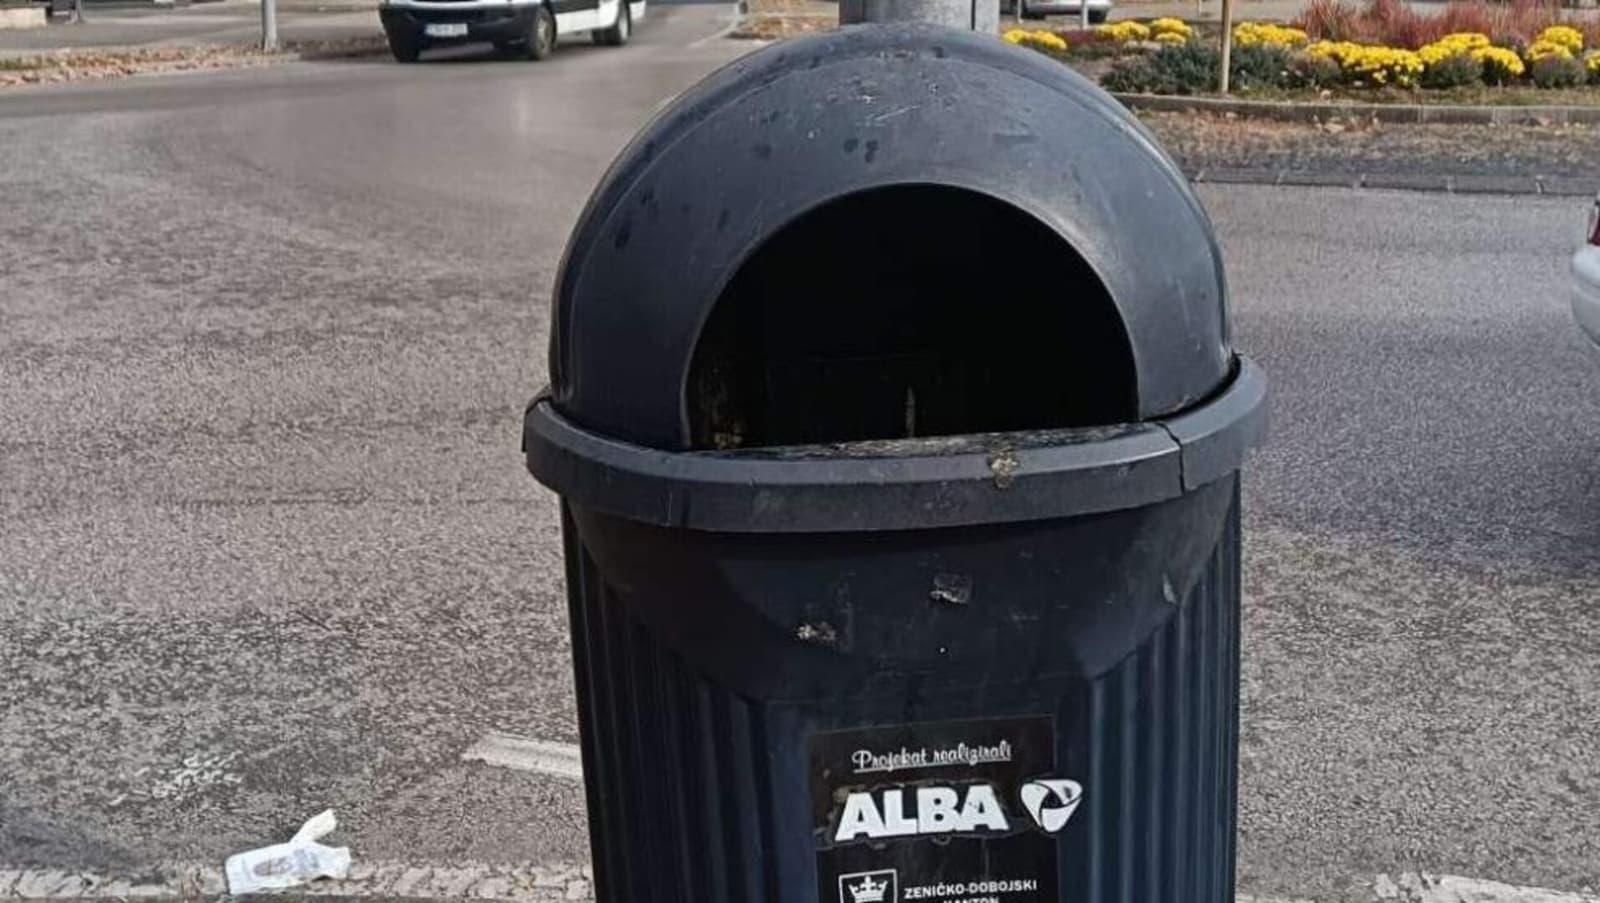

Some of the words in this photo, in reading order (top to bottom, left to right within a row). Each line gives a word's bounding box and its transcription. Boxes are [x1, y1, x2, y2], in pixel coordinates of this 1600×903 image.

[851, 748, 928, 772] Projekat
[932, 739, 1012, 766] realizirali
[835, 784, 1009, 841] ALBA
[904, 879, 1038, 899] ZENIČKO-DOBOJSKI
